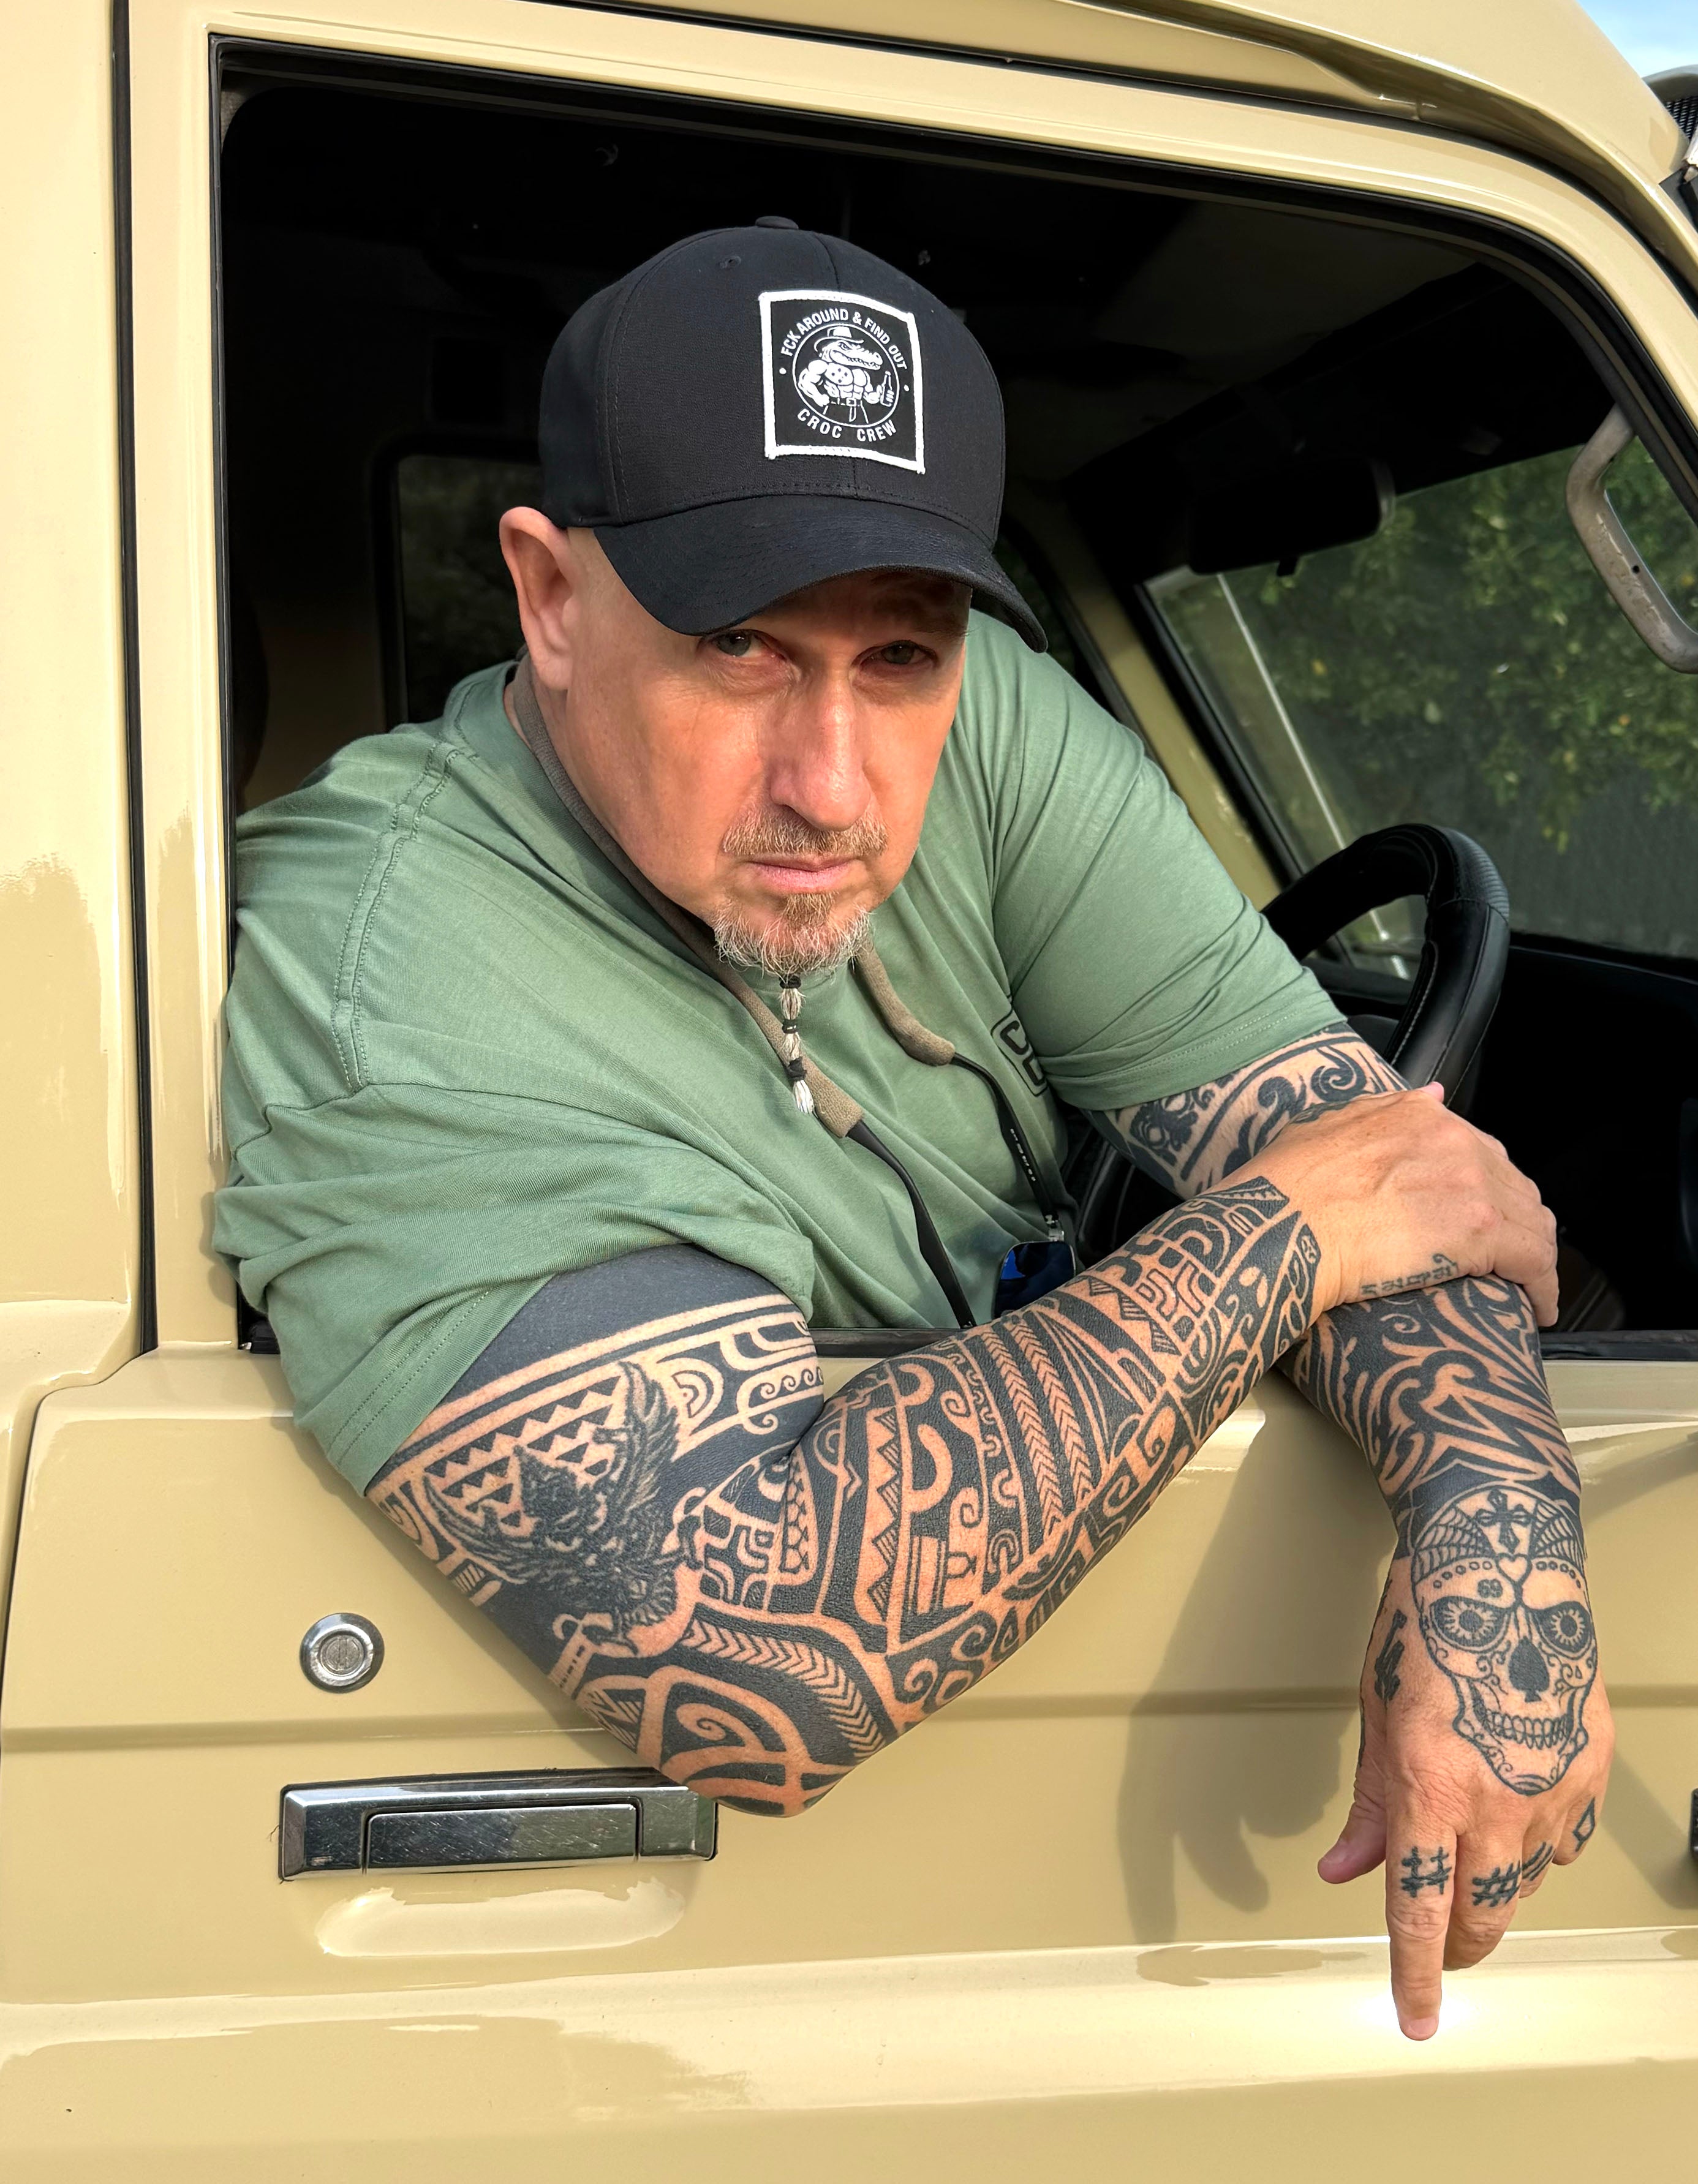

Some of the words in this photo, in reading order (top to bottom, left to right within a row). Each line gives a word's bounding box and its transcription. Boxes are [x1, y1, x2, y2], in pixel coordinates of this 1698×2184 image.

[781, 330, 801, 356] FCK
[796, 308, 849, 331] AROUND
[852, 311, 862, 325] &
[864, 317, 891, 344] FIND
[888, 345, 907, 370] OUT
[797, 408, 842, 439] CROC
[856, 420, 897, 442] CREW
